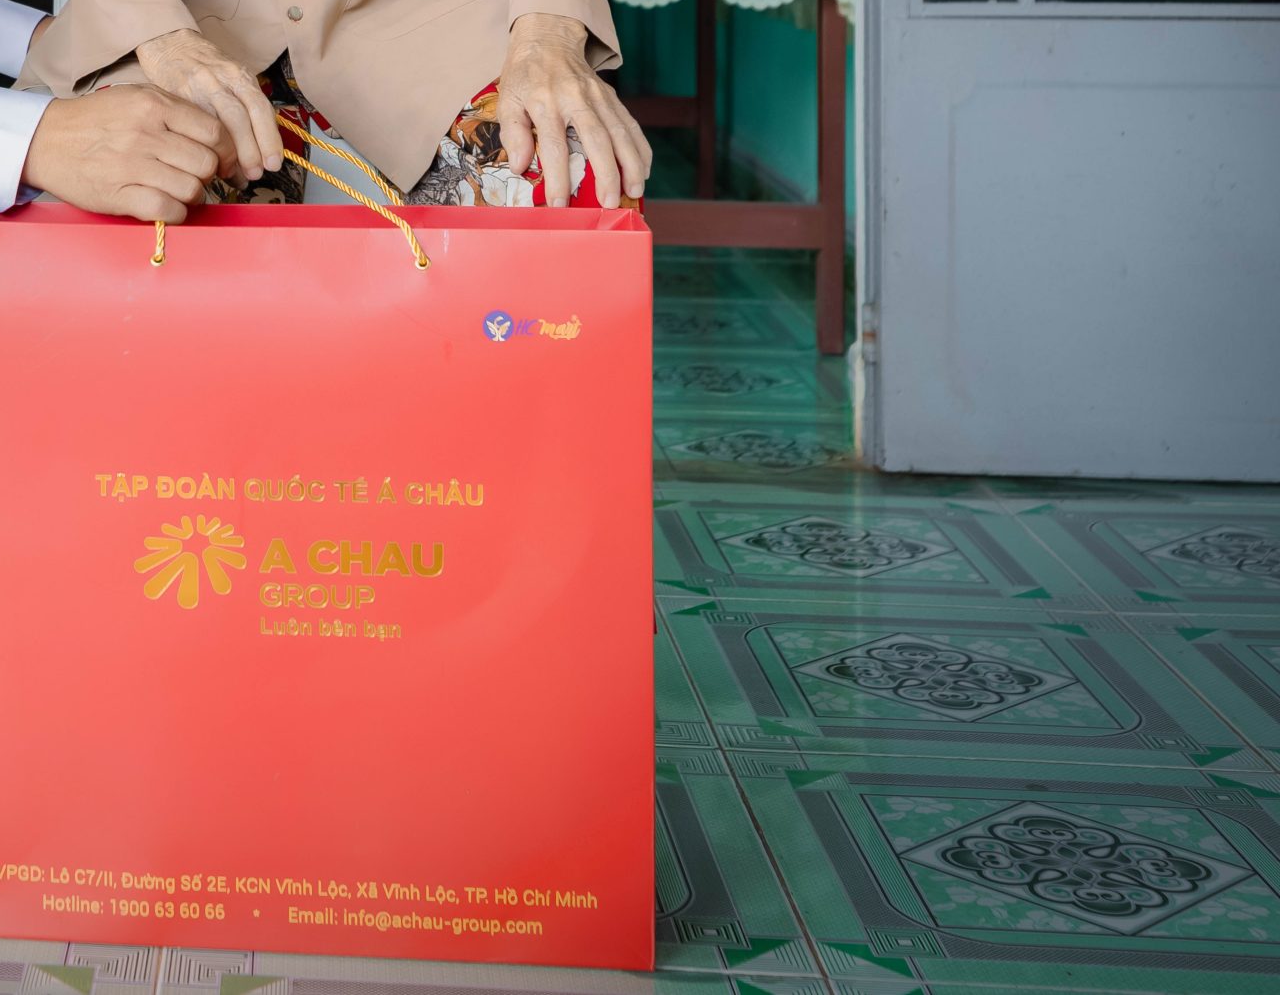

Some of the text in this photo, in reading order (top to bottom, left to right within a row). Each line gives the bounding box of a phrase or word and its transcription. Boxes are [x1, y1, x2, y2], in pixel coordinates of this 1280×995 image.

[95, 472, 149, 503] TẬP
[155, 472, 235, 501] ĐOÀN
[244, 474, 325, 503] QUỐC
[376, 476, 397, 504] Á
[405, 477, 484, 506] CHÂU
[259, 538, 444, 577] A CHAU
[259, 583, 375, 610] GROUP
[260, 617, 401, 642] Luôn bên bạn
[50, 866, 70, 884] Lô
[121, 872, 175, 894] Đường
[180, 873, 202, 892] Số
[207, 876, 230, 894] 2E,
[235, 877, 270, 894] KCN
[275, 877, 313, 896] Vĩnh
[318, 880, 352, 900] Lộc,
[357, 882, 378, 899] Xã
[382, 883, 420, 901] Vĩnh
[425, 885, 460, 905] Lộc,
[464, 886, 489, 905] TP.
[494, 887, 518, 905] Hồ
[523, 889, 551, 907] Chí
[555, 891, 598, 909] Minh
[42, 894, 225, 920] Hotline: 1900 63 60 66
[288, 907, 543, 936] Email: info@achau-group.com
